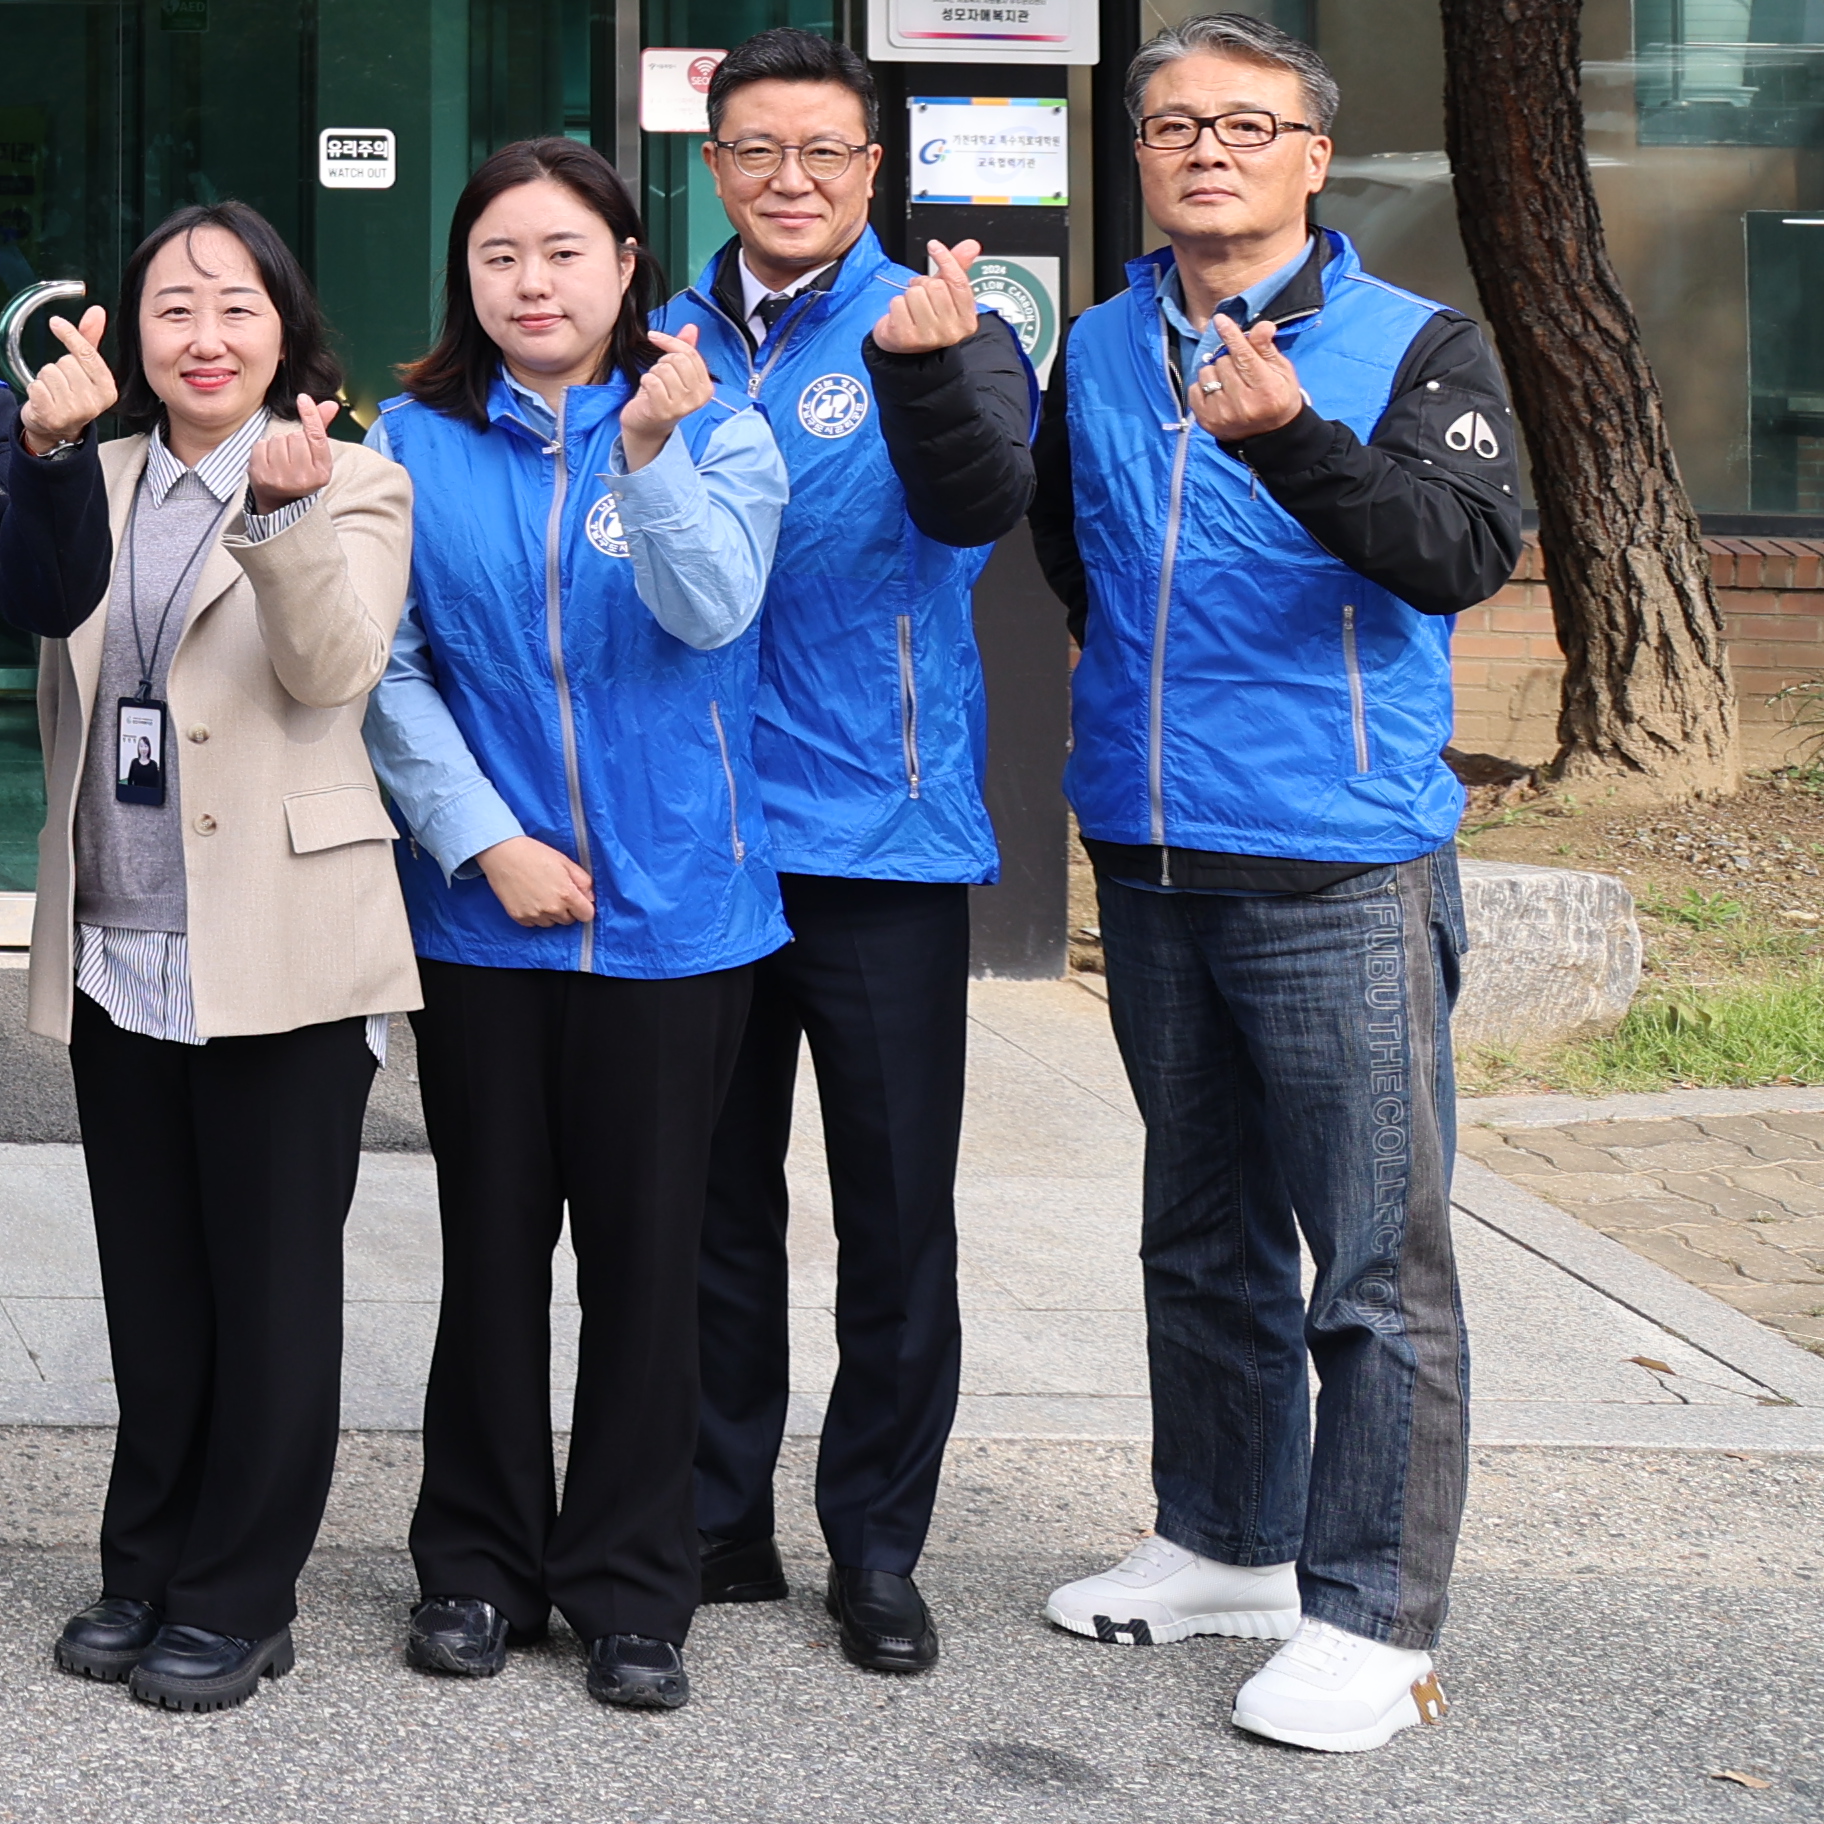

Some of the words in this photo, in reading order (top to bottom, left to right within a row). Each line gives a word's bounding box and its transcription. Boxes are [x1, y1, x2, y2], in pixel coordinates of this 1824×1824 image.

[180, 1, 206, 13] AED
[941, 7, 1031, 23] 성모자애복지관
[327, 139, 388, 158] 유리주의
[328, 167, 364, 178] WATCH
[367, 167, 387, 178] OUT
[981, 264, 1007, 275] 2024
[982, 280, 1005, 291] LOW
[1008, 286, 1036, 323] CARBON
[1363, 903, 1401, 1011] FUBU
[1367, 1014, 1403, 1095] THE
